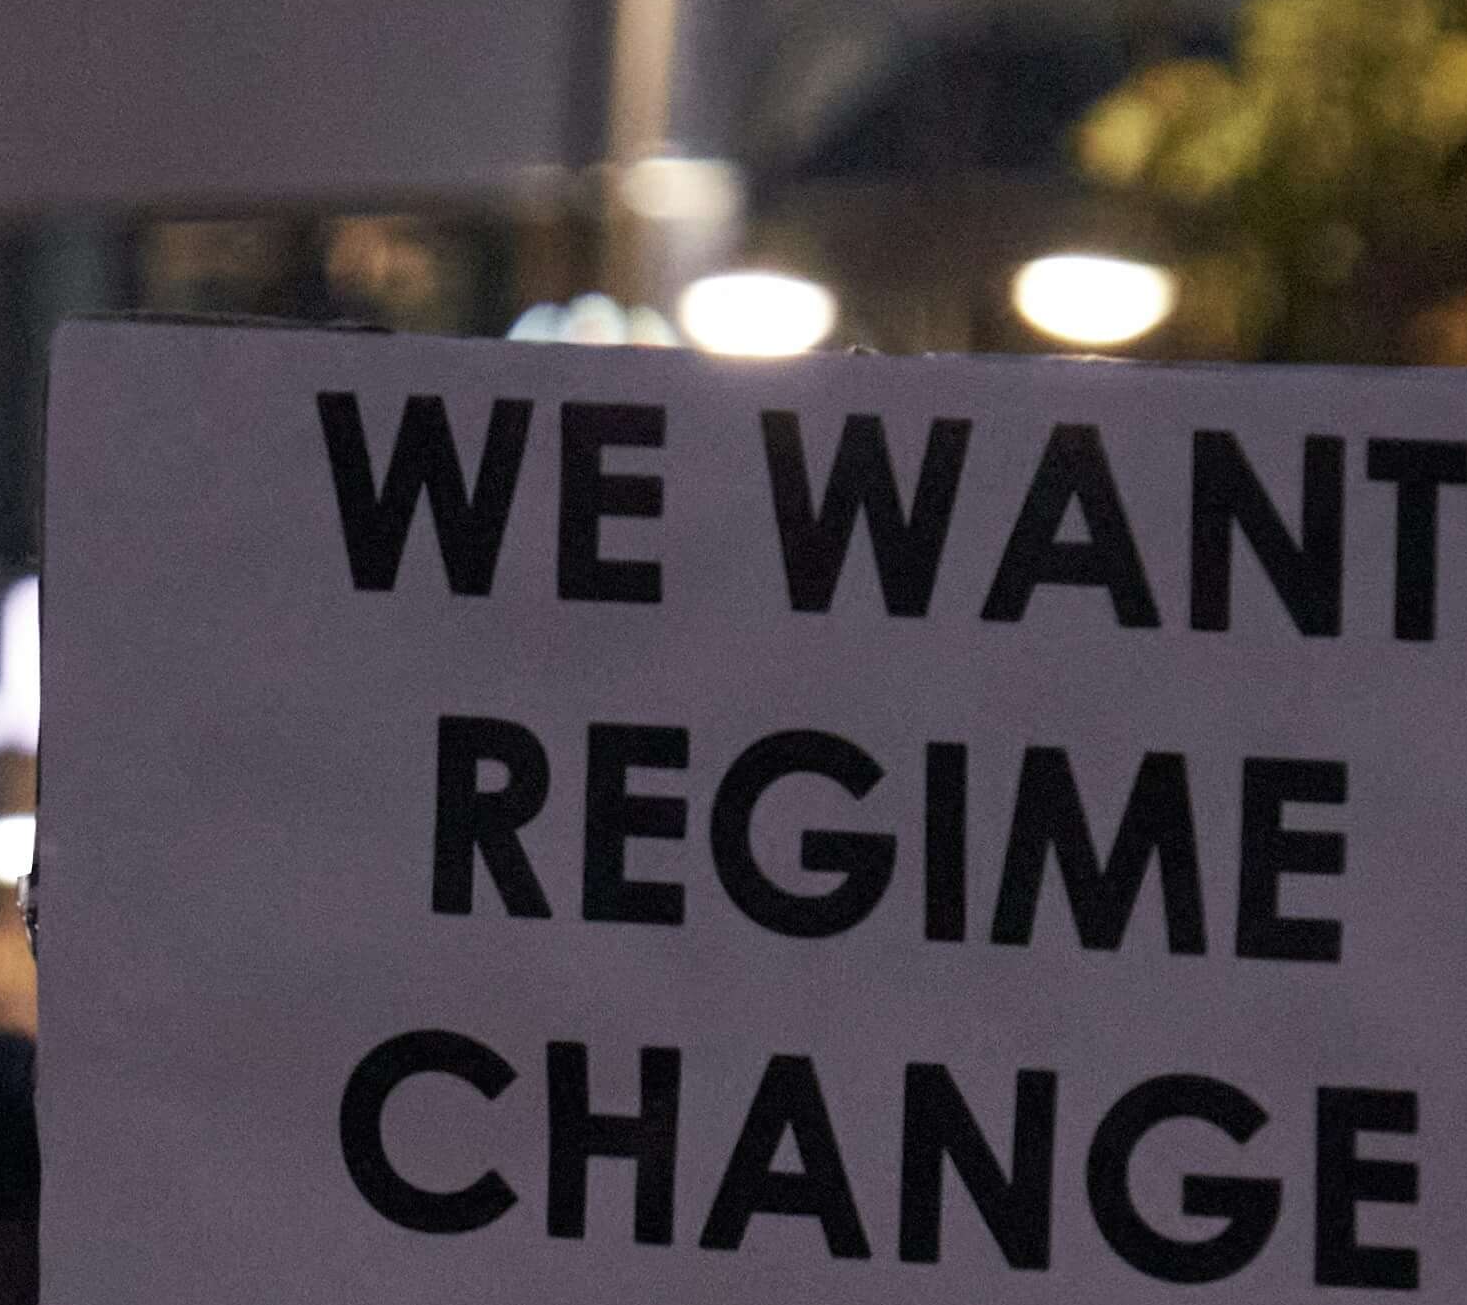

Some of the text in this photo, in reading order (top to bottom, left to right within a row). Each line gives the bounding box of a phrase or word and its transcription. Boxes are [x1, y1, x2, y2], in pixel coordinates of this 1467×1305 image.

[316, 390, 666, 605] WE
[431, 714, 1349, 964] REGIME
[338, 1028, 1420, 1292] CHANGE
